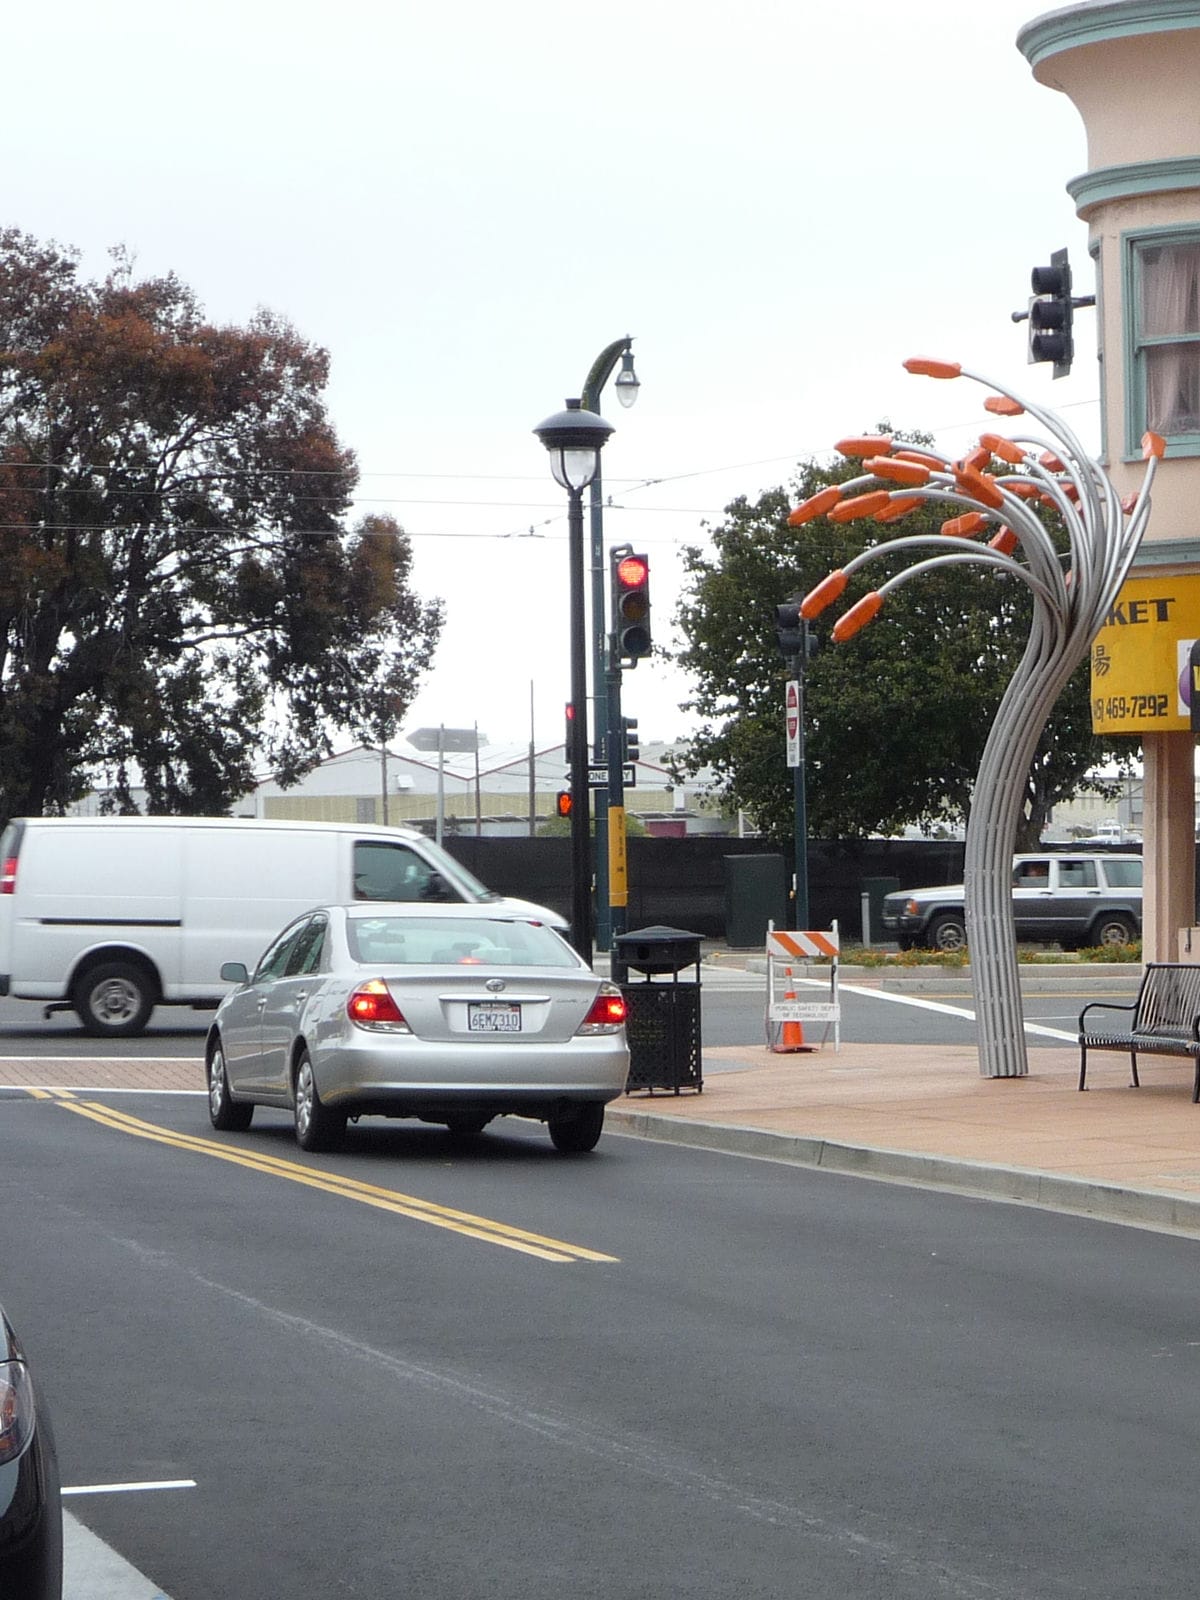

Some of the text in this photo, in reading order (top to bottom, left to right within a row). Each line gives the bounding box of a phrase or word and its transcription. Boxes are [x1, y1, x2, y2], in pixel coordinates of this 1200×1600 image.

[1103, 597, 1176, 628] KET
[588, 771, 607, 781] ONE
[472, 1013, 518, 1027] 6EMZ310
